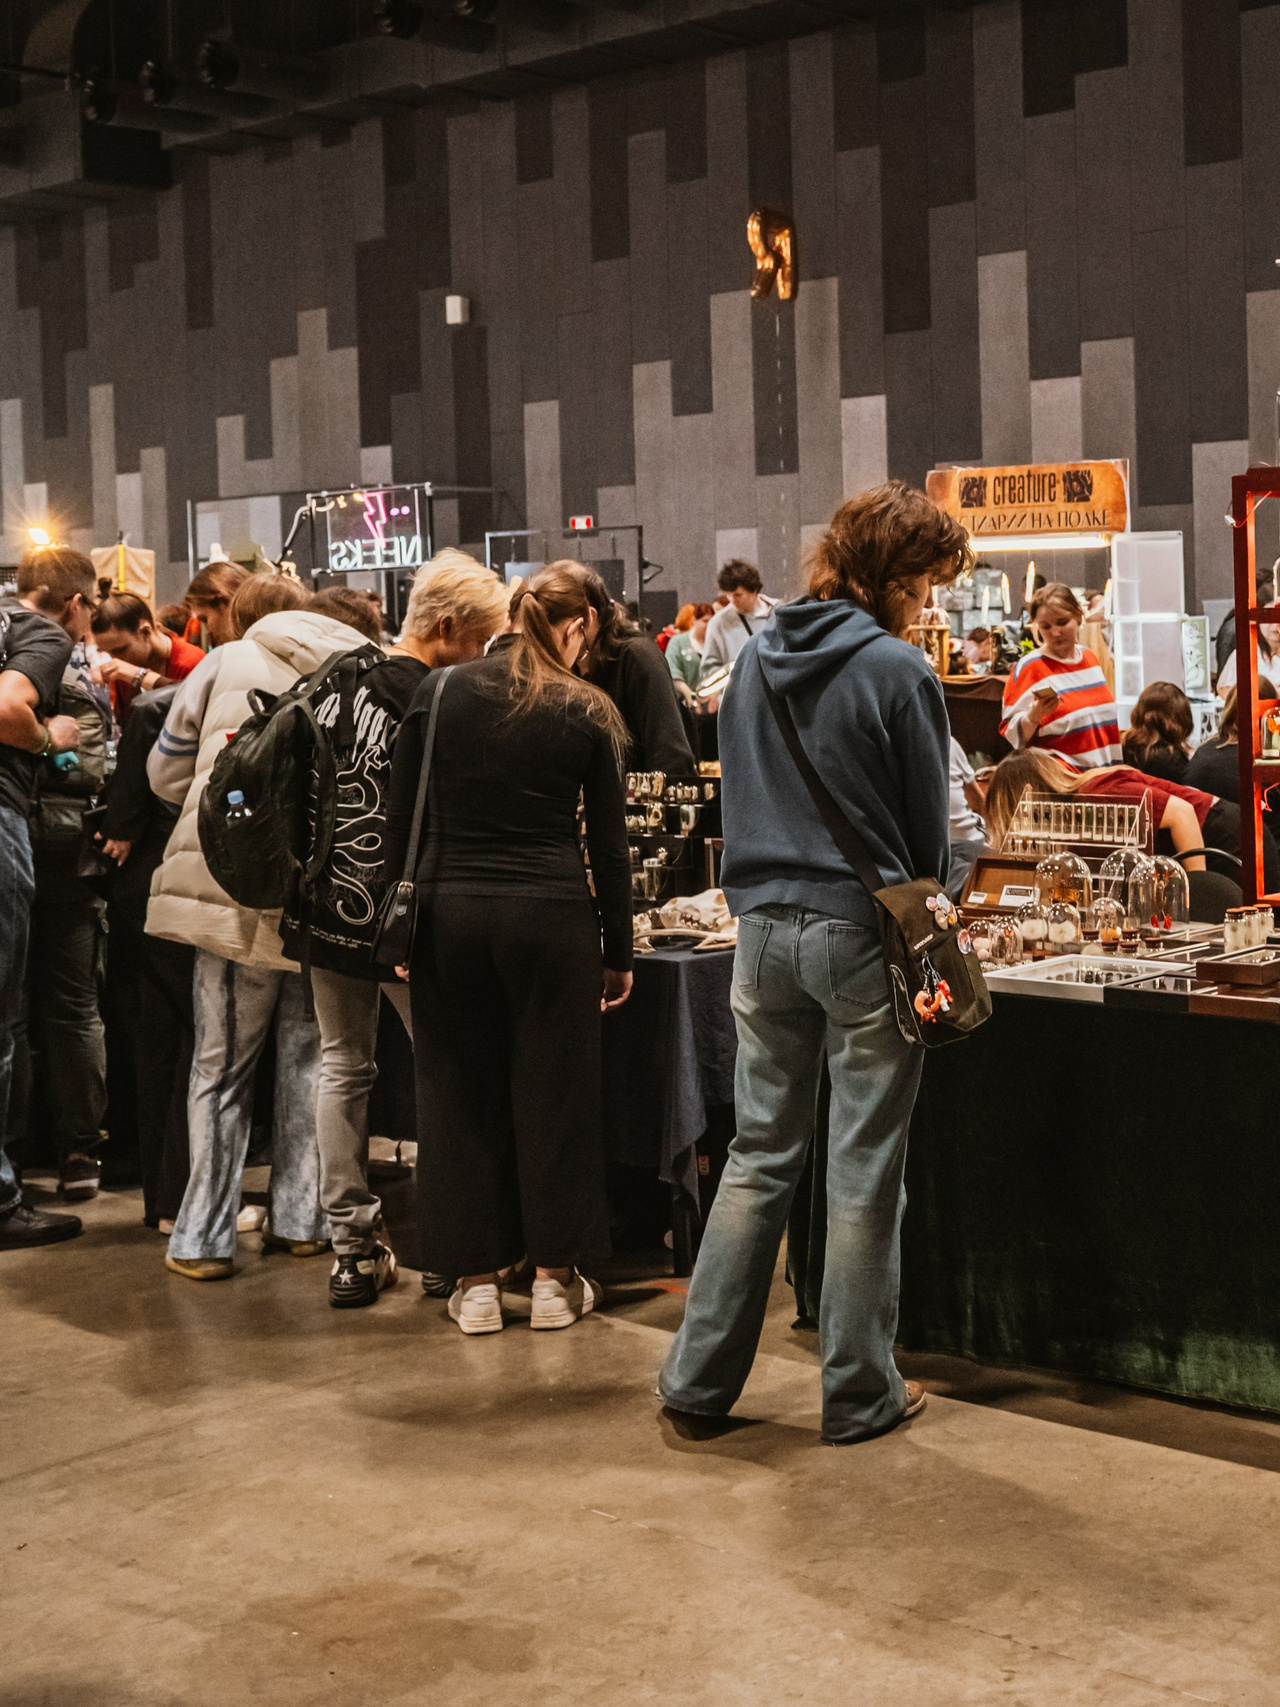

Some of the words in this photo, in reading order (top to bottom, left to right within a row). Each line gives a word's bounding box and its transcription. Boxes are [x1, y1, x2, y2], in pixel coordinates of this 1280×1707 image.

[993, 469, 1057, 506] creature
[1031, 512, 1053, 529] НА
[1057, 509, 1112, 528] ПОЛКЕ
